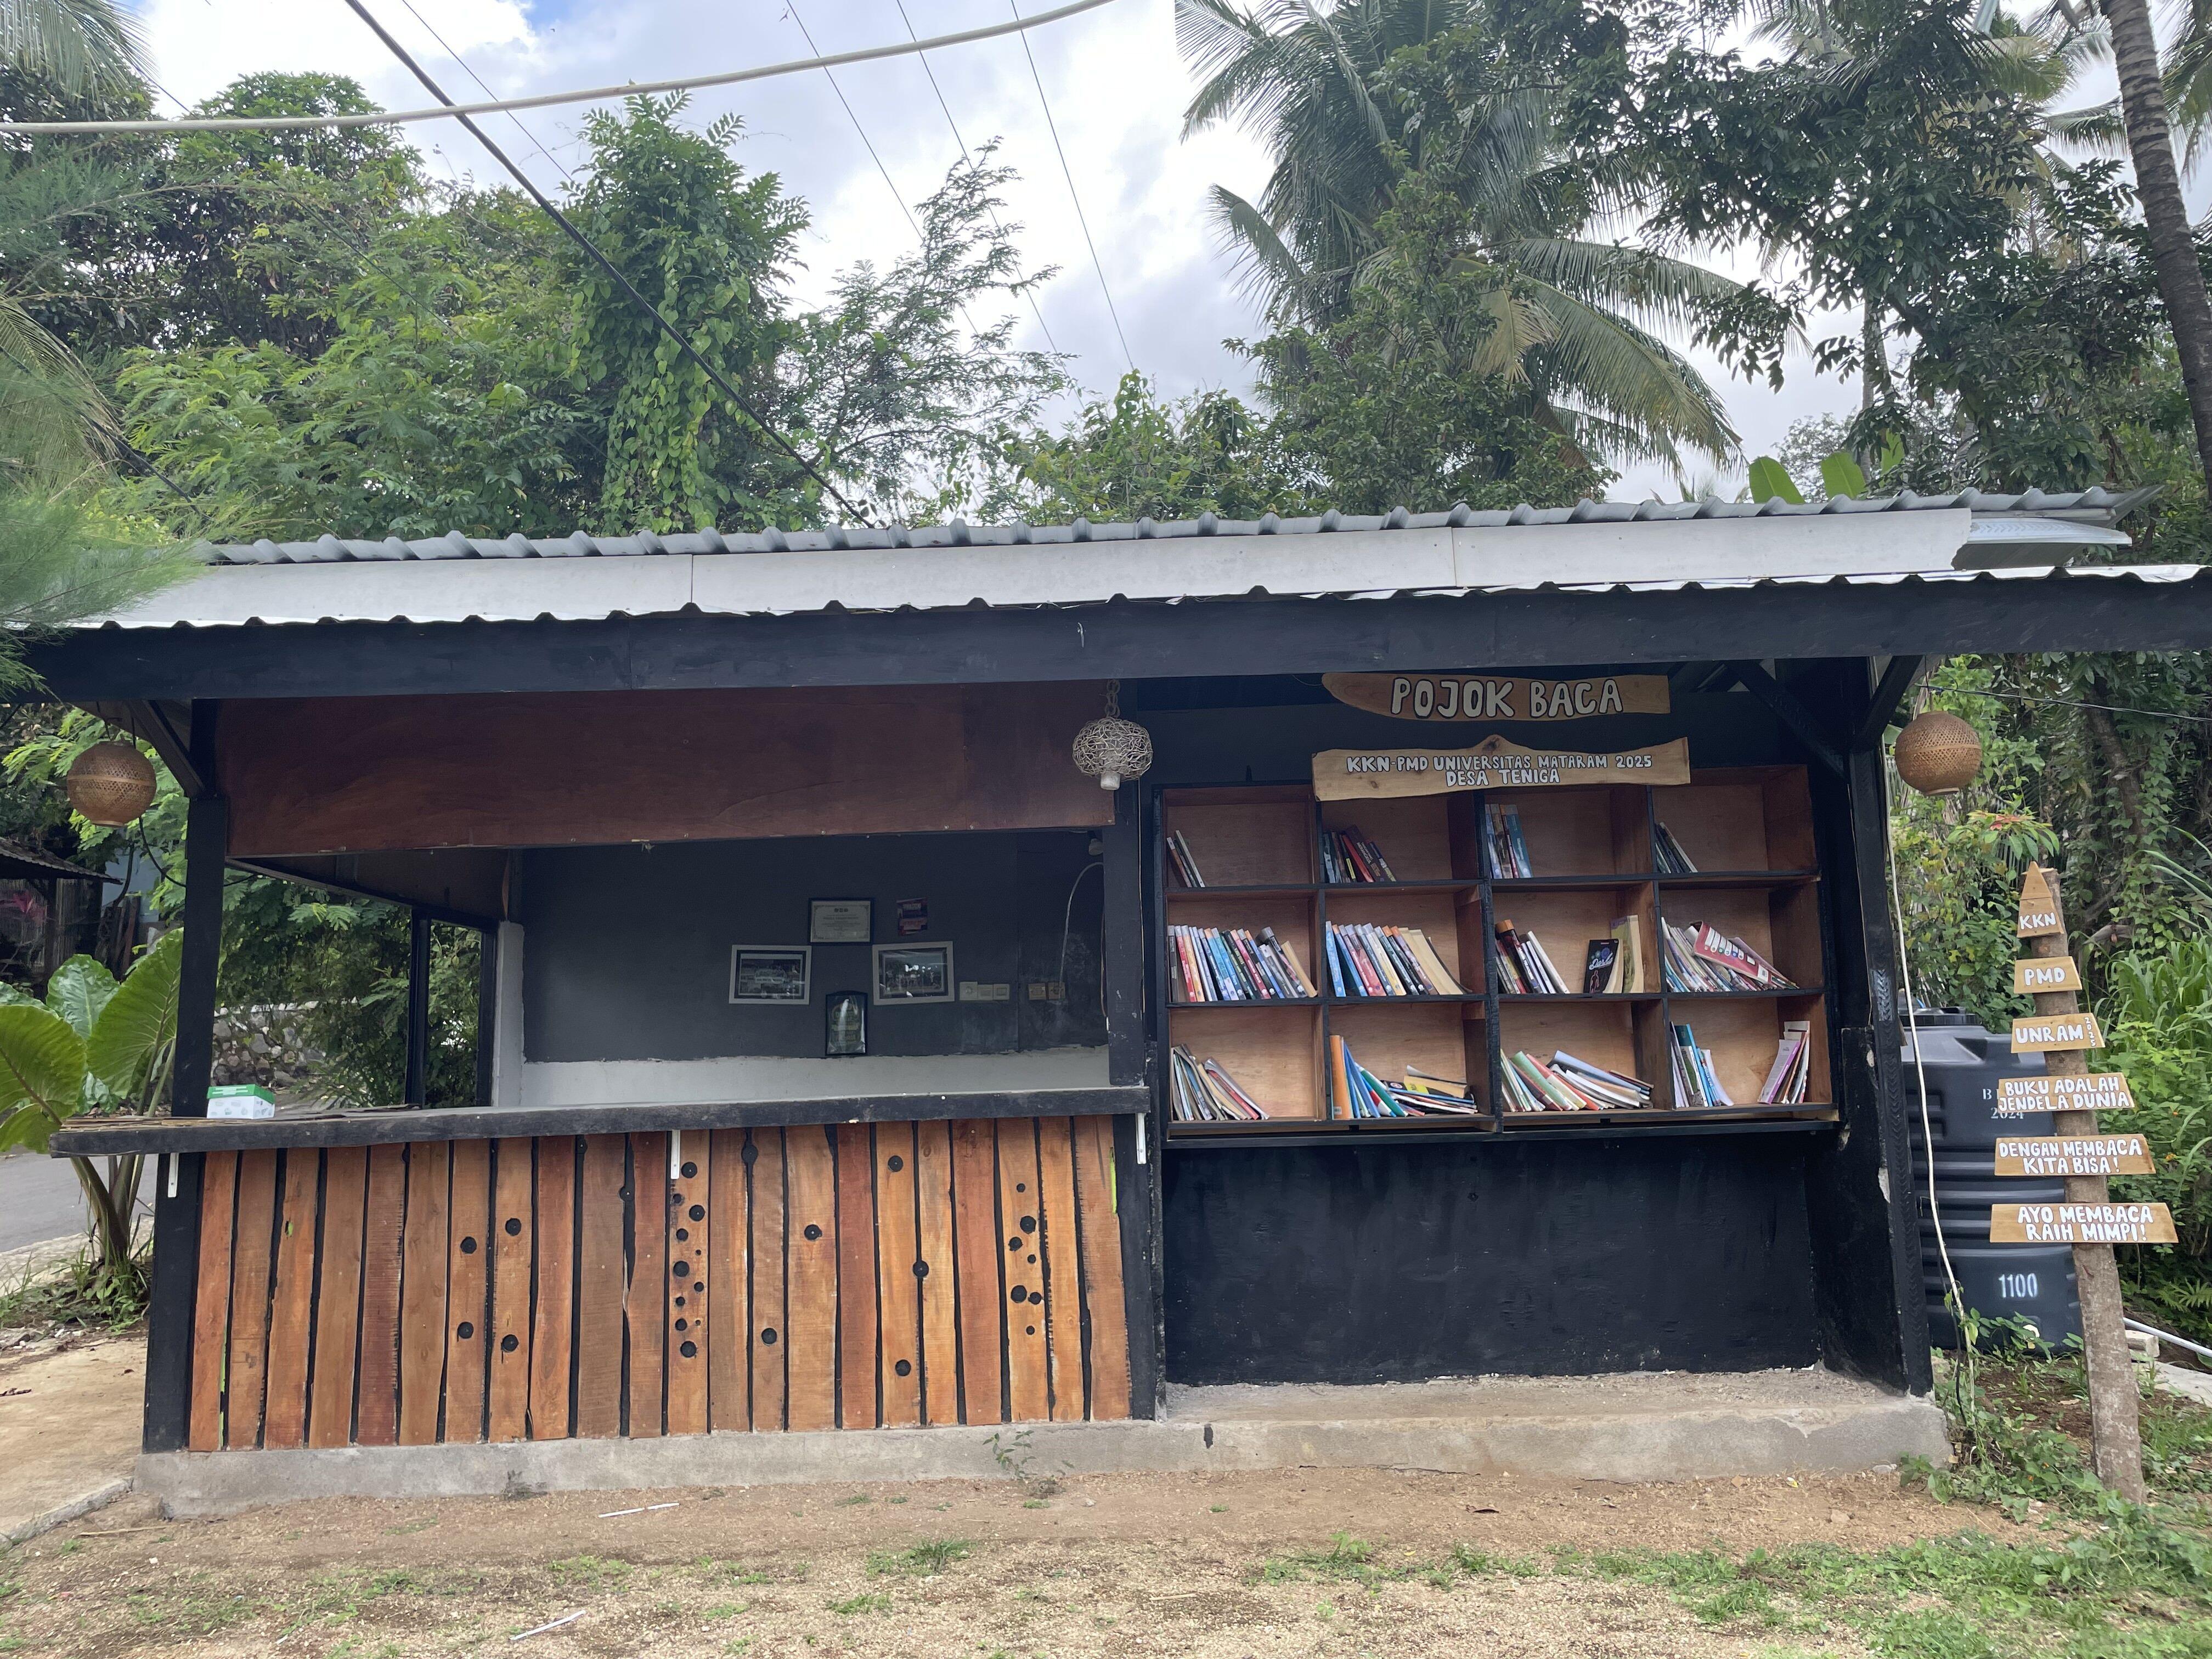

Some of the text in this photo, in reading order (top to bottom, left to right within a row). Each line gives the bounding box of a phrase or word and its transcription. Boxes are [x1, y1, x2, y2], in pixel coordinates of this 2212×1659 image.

[1391, 678, 1623, 718] POJOK BACA
[1347, 754, 1653, 773] KKN-PMD UNIVERSITAS MATARAM 2025
[1446, 769, 1560, 787] DESA TENIGA
[2019, 912, 2057, 930] KKN
[2024, 967, 2066, 986] PMD
[2015, 1024, 2084, 1043] UNRAM
[2084, 1017, 2096, 1047] 2025
[2005, 1080, 2049, 1097] BUKU
[2054, 1076, 2119, 1093] ADALAH
[1998, 1091, 2130, 1112] JENDELA DUNIA
[1999, 1138, 2142, 1158] DENGAN MEMBACA
[2023, 1157, 2069, 1175] KITA
[2018, 1205, 2154, 1224] AYO MEMBACA
[2025, 1223, 2074, 1241] RAIH
[1997, 1273, 2038, 1299] 1100
